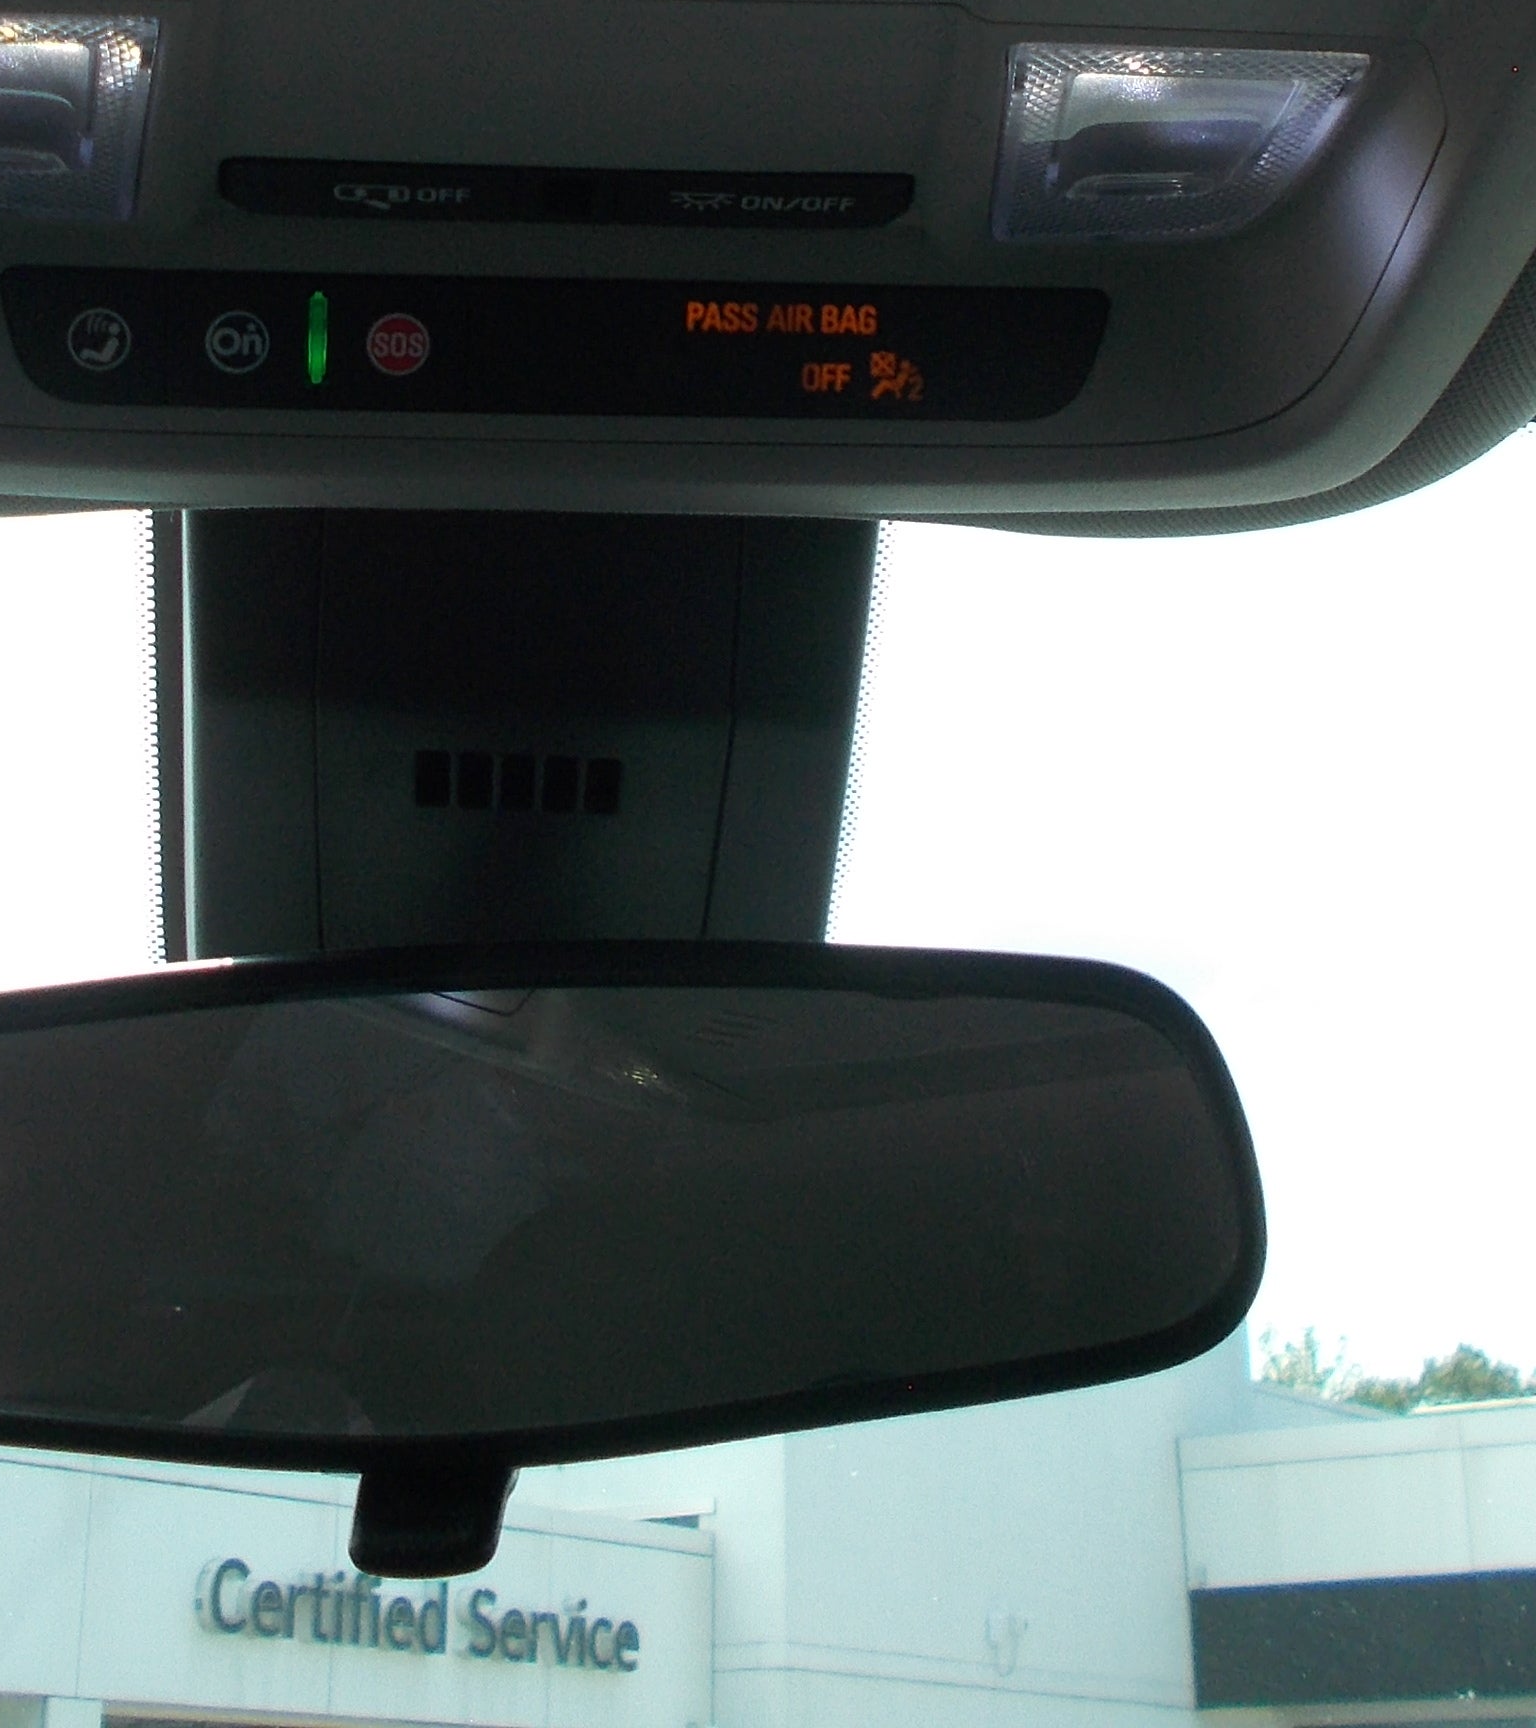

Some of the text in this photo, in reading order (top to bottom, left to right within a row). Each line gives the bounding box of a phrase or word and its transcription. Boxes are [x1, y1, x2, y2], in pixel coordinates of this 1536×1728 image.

[415, 186, 471, 204] OFF
[740, 194, 856, 213] ON/OFF
[683, 299, 880, 336] PASS AIR BAG
[213, 324, 263, 358] On
[372, 330, 425, 359] SOS
[800, 360, 853, 394] OFF
[208, 1556, 641, 1672] Certified Service
